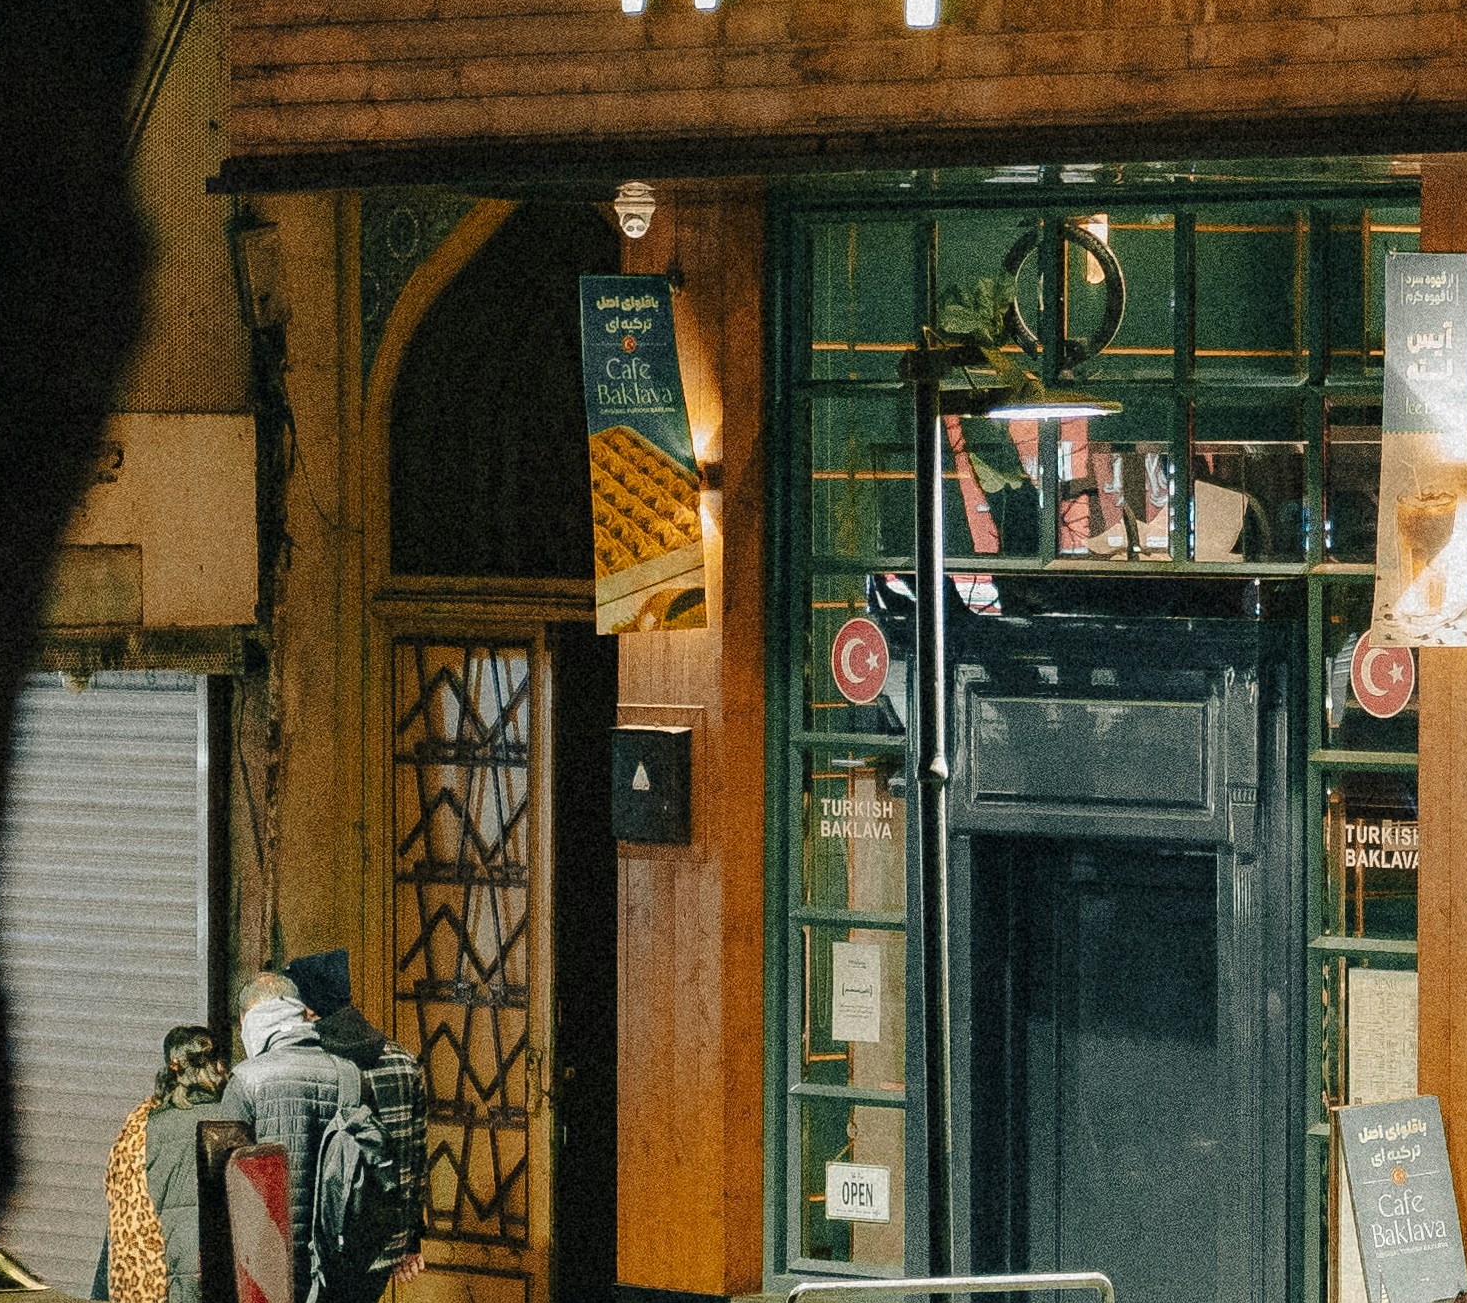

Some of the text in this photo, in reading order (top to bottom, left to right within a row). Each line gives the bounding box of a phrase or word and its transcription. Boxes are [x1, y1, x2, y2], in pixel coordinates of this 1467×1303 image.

[605, 356, 652, 381] Cafe
[597, 382, 673, 406] Baklava
[820, 798, 893, 818] TURKISH
[820, 820, 893, 840] BAKLAVA
[841, 1181, 874, 1208] OPEN
[1377, 1189, 1426, 1218] Cafe
[1370, 1217, 1448, 1249] Baklava
